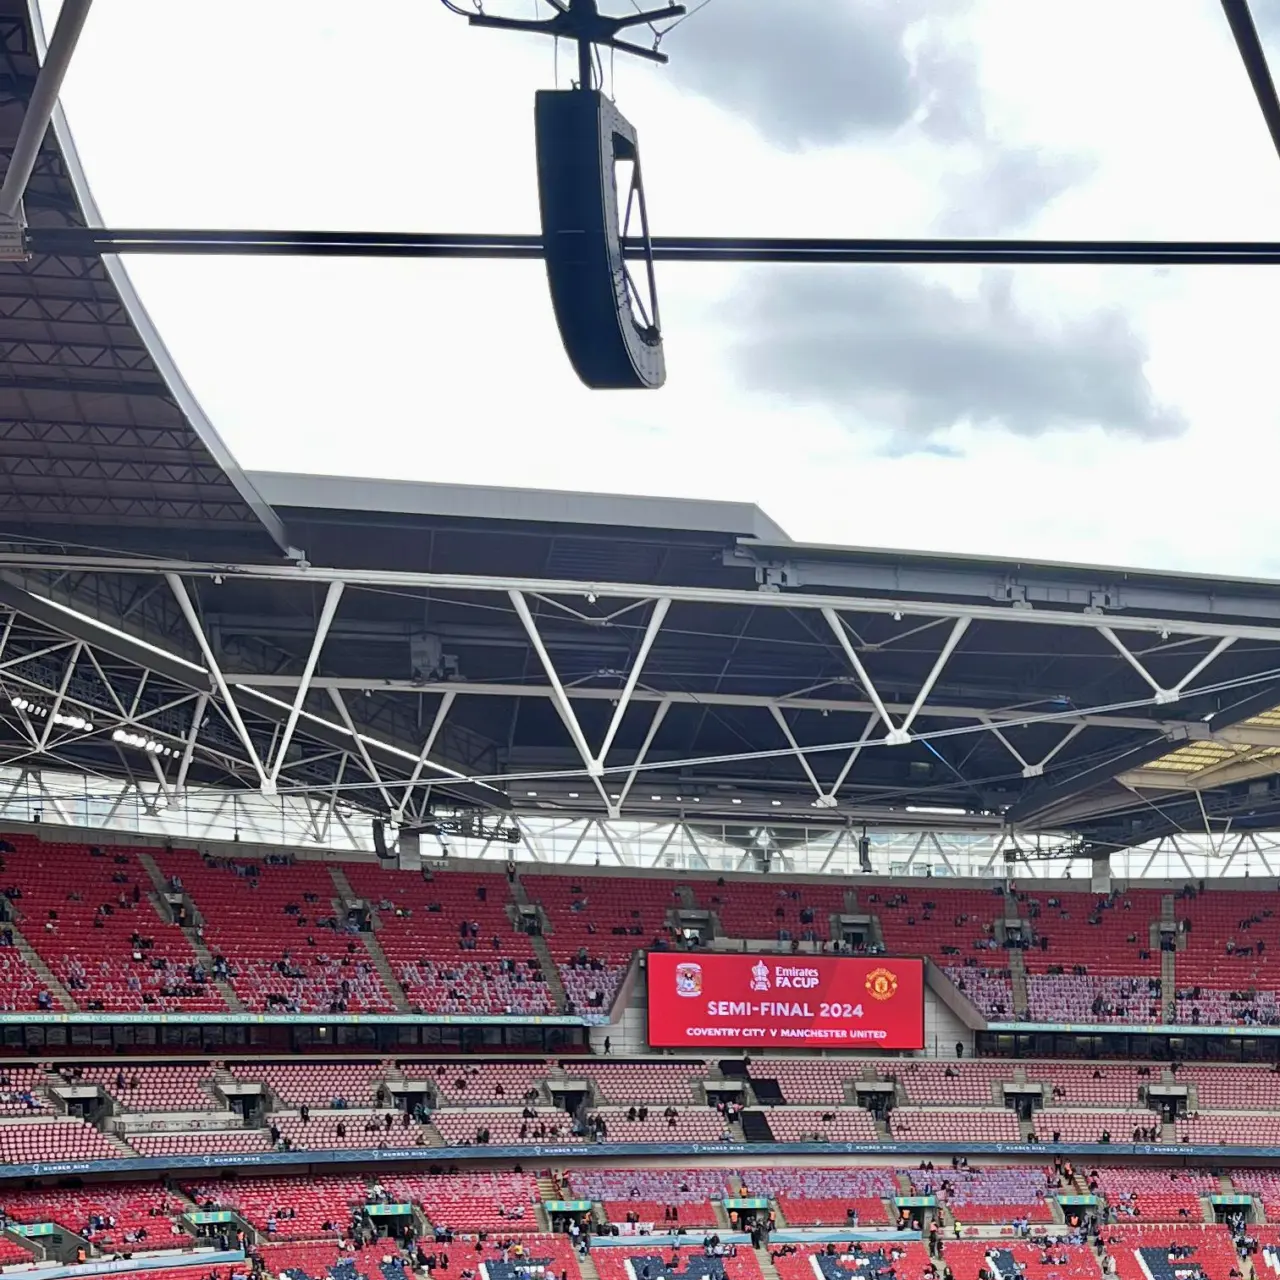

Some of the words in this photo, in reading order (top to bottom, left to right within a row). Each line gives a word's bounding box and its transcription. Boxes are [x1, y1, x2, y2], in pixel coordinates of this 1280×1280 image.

[776, 966, 819, 977] Emirates
[776, 977, 791, 987] FA
[793, 977, 819, 988] CUP
[707, 1001, 814, 1017] SEMI-FINAL
[819, 1003, 864, 1018] 2024
[686, 1027, 741, 1037] COVENTRY
[743, 1028, 766, 1037] CITY
[770, 1029, 777, 1037] V
[781, 1028, 847, 1038] MANCHESTER
[850, 1030, 887, 1039] UNITED
